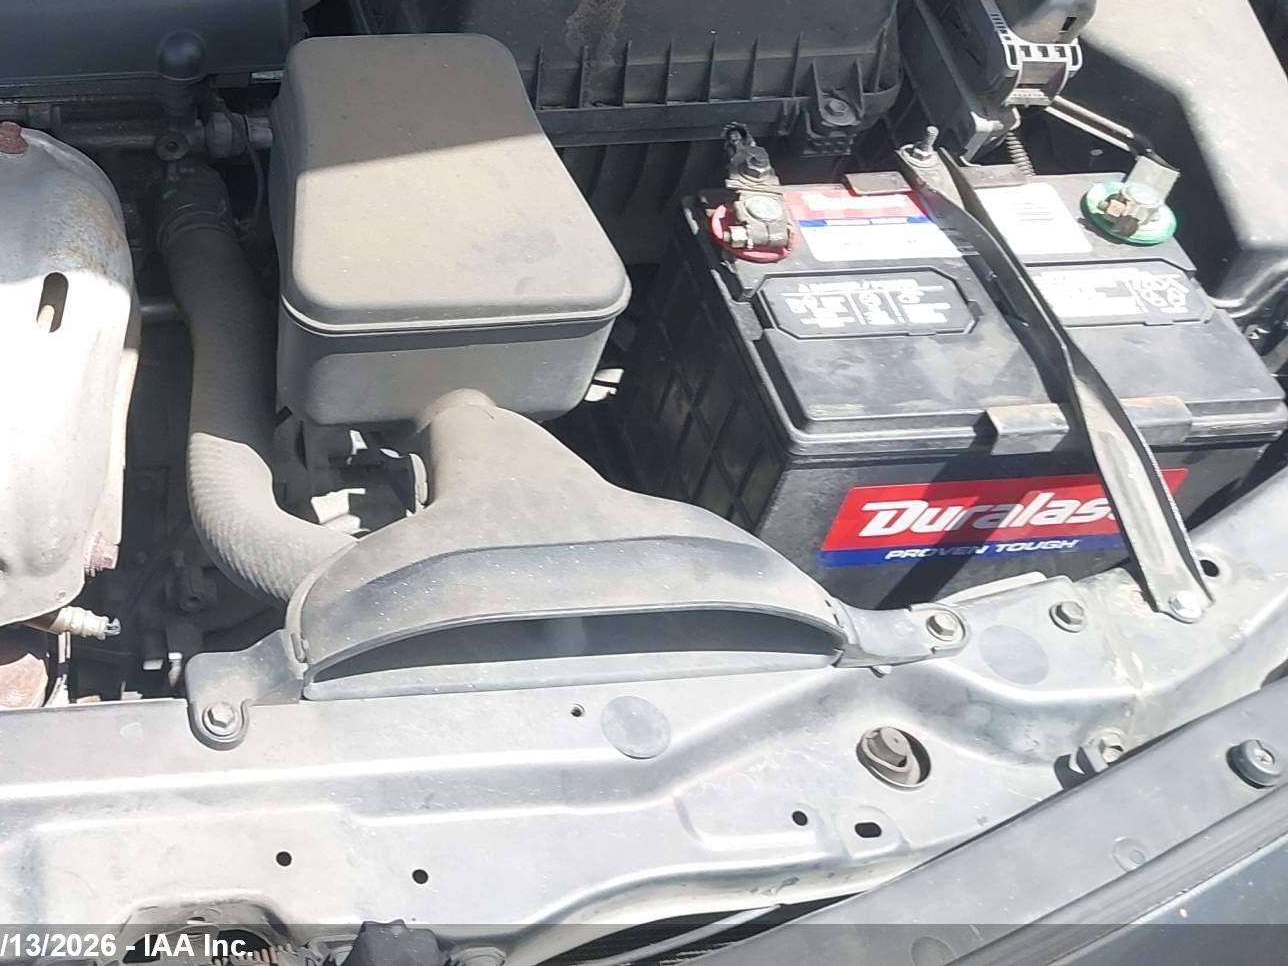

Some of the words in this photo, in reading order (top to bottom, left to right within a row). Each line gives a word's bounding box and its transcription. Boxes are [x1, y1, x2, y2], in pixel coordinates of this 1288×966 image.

[857, 491, 1117, 537] Duralas
[884, 544, 990, 561] PROVEN
[995, 538, 1081, 554] TOUGH
